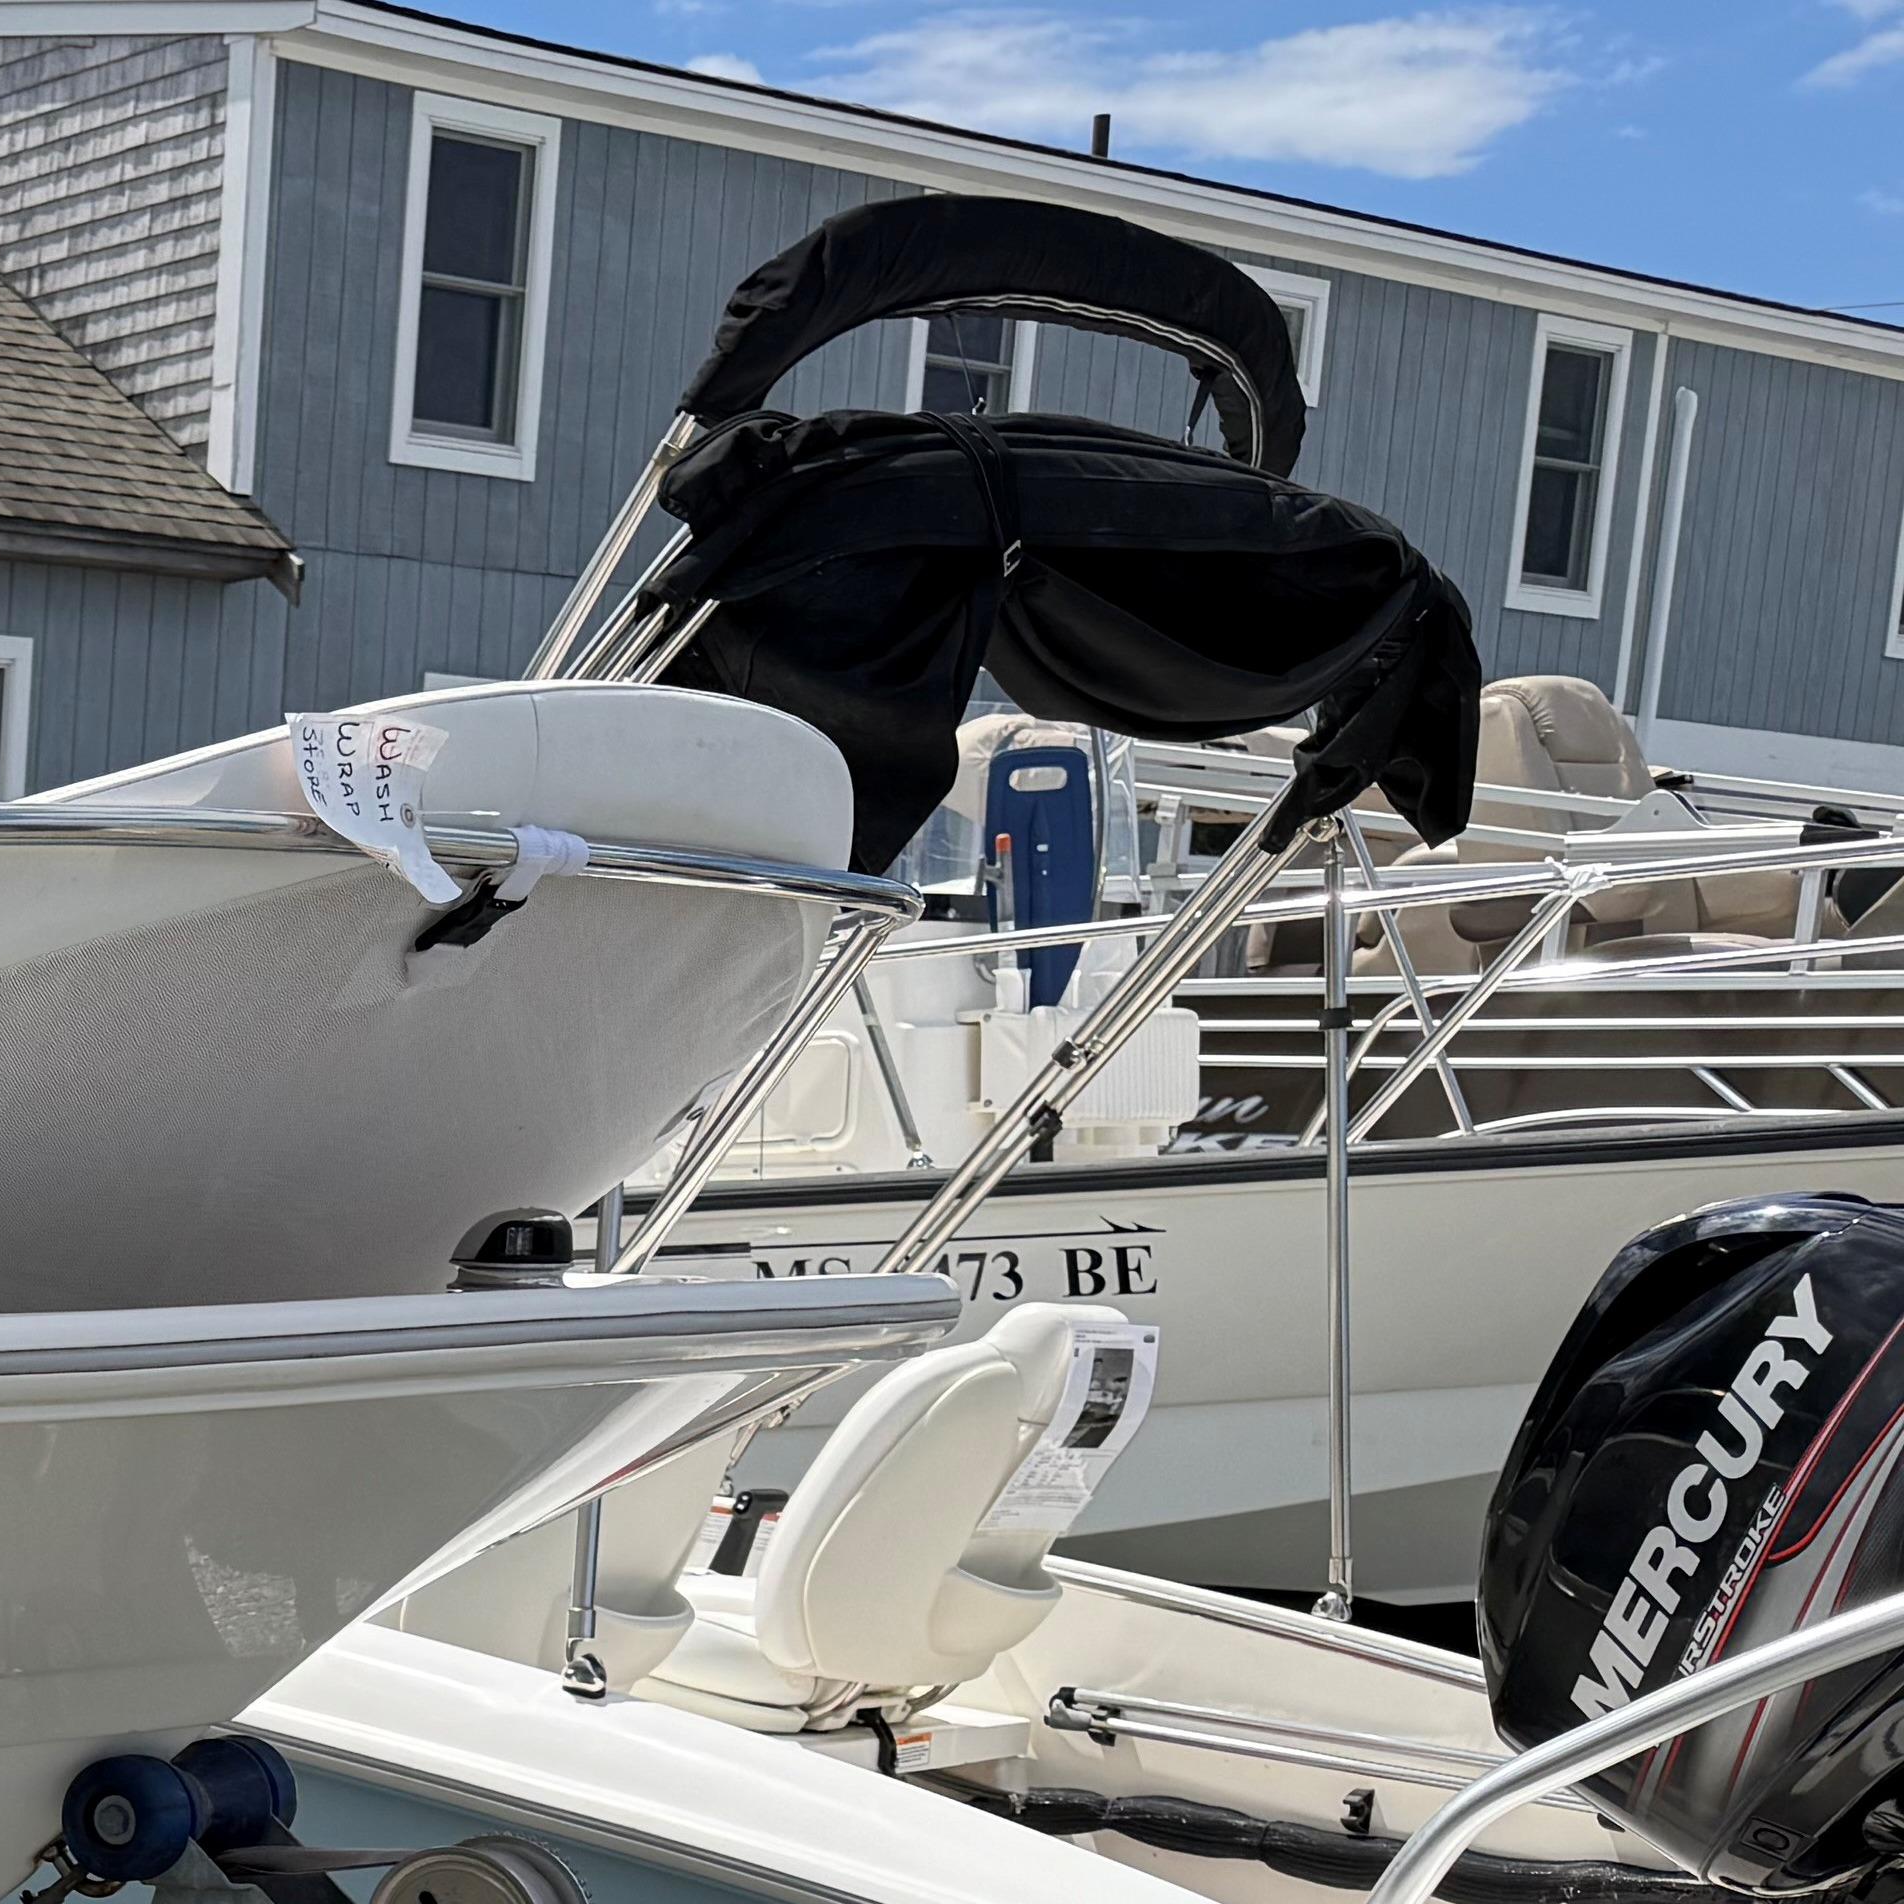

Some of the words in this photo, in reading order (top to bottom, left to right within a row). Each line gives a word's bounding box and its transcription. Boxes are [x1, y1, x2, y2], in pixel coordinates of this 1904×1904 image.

[337, 722, 360, 816] WRAP
[376, 727, 410, 822] WASH
[1059, 1245, 1158, 1298] BE
[1570, 1273, 1833, 1721] MERCURY
